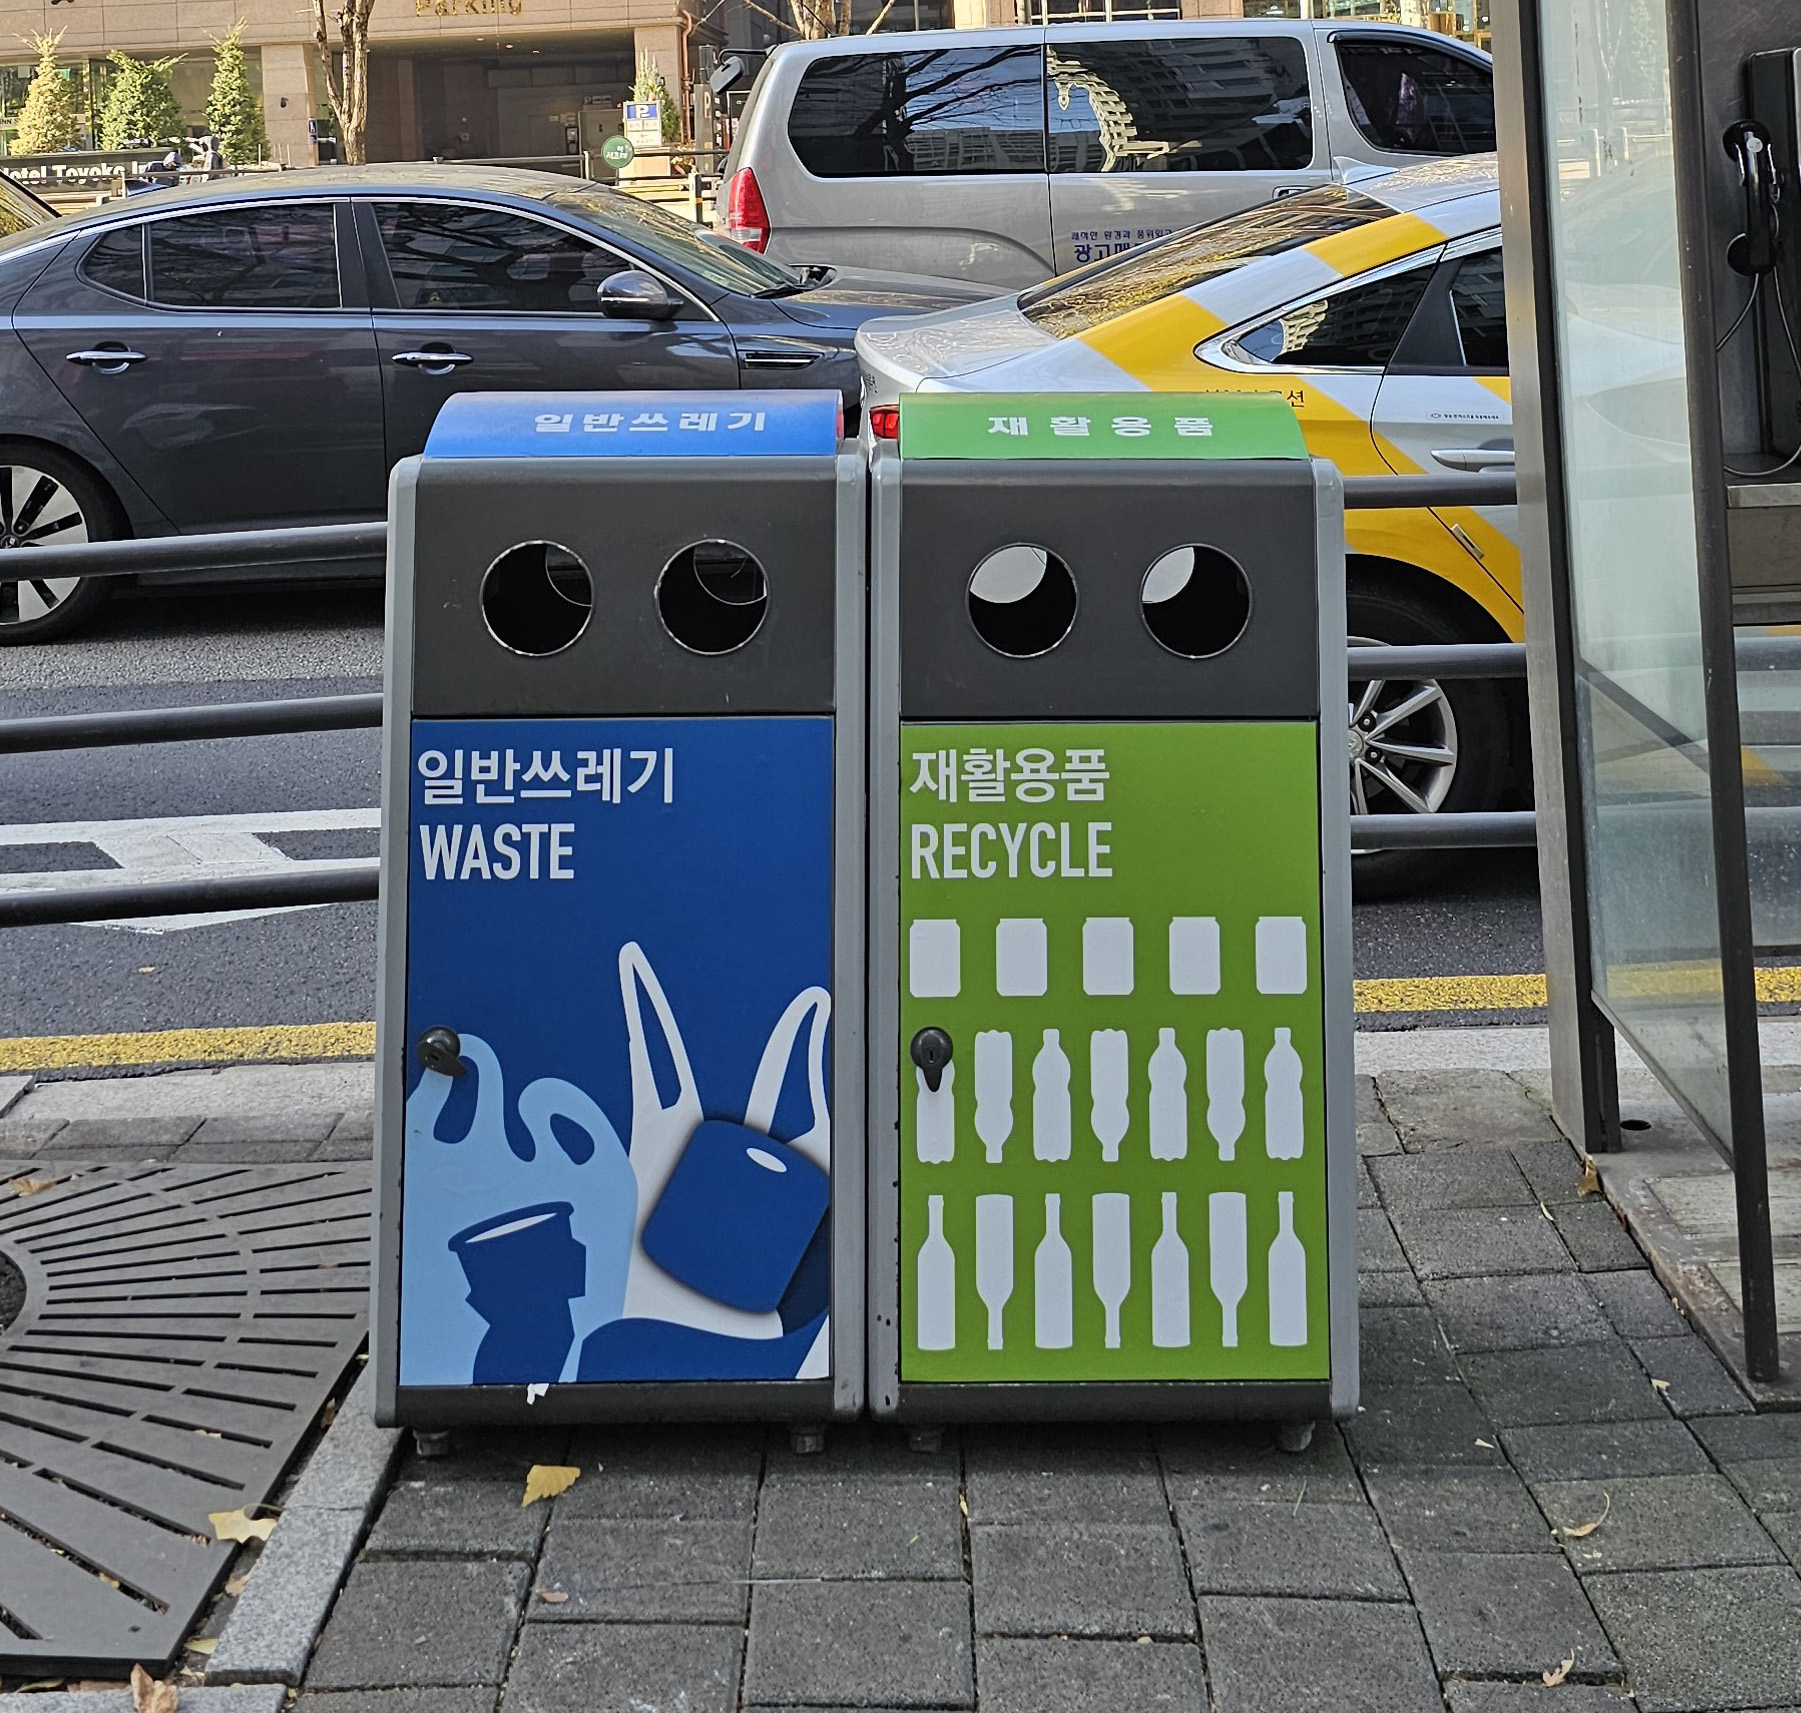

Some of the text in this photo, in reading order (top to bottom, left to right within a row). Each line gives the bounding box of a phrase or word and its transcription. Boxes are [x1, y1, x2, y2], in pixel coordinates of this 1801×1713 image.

[635, 104, 650, 119] P
[3, 165, 47, 184] otel
[534, 412, 766, 433] 일반쓰레기
[987, 416, 1214, 437] 재활용품
[418, 747, 674, 805] 일반쓰레기
[909, 747, 1110, 803] 재활용품
[419, 822, 575, 880] WASTE
[911, 821, 1113, 880] RECYCLE
